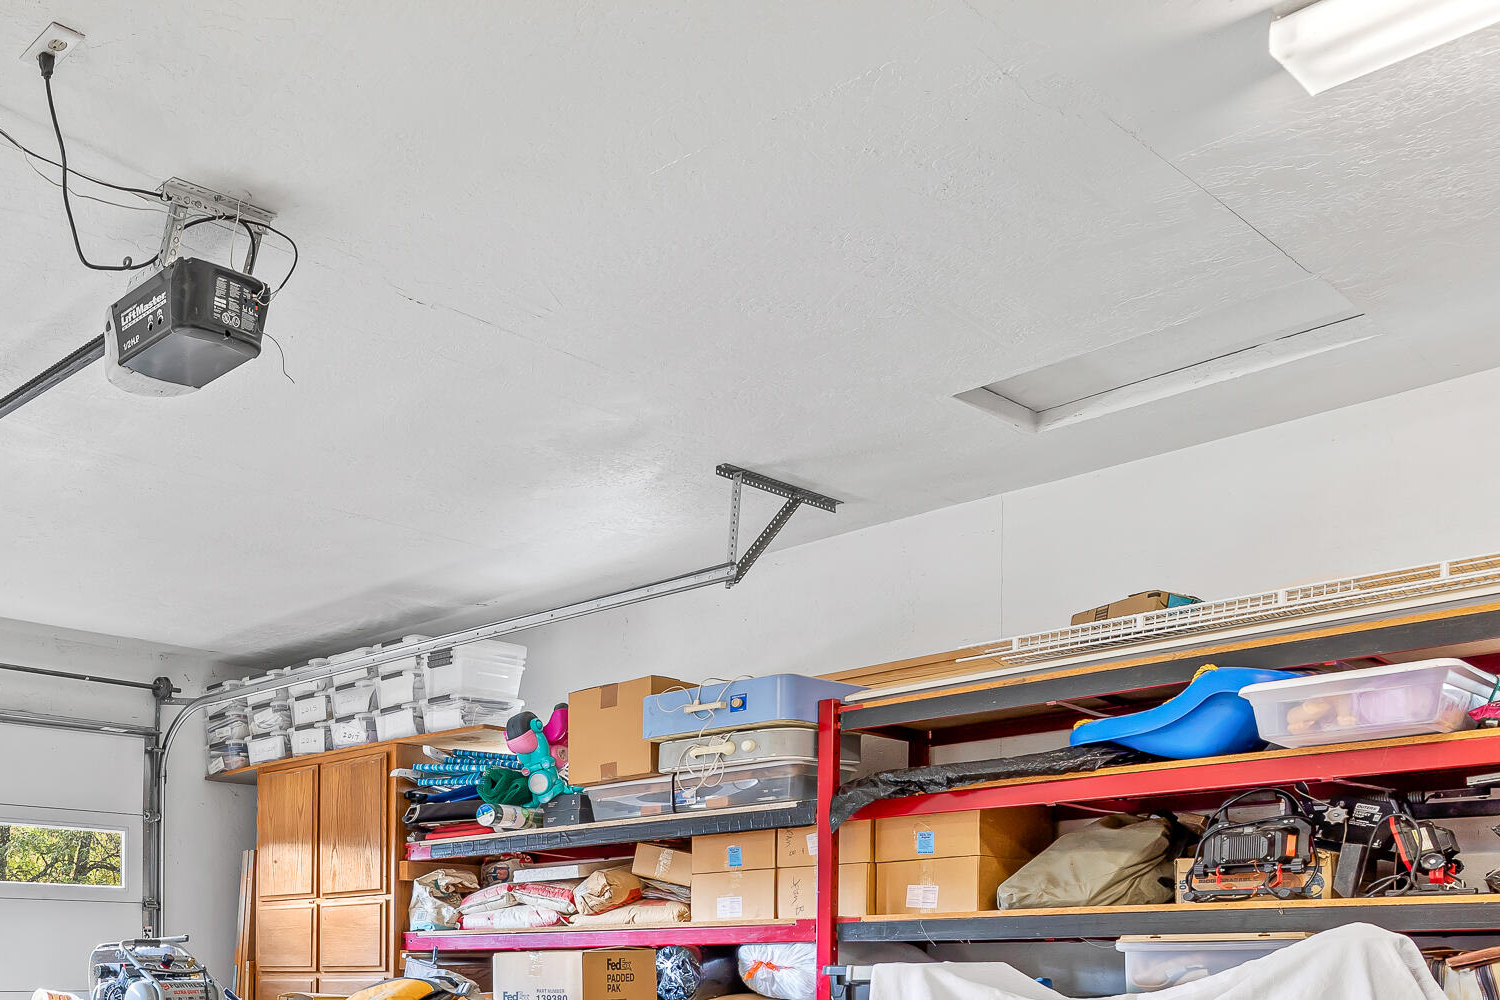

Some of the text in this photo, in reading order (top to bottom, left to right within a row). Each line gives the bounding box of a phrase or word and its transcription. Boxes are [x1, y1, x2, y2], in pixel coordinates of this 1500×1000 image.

[121, 291, 167, 327] LiftMaster
[606, 957, 633, 971] FedEx
[606, 973, 635, 983] PADDED
[606, 983, 622, 993] PAK
